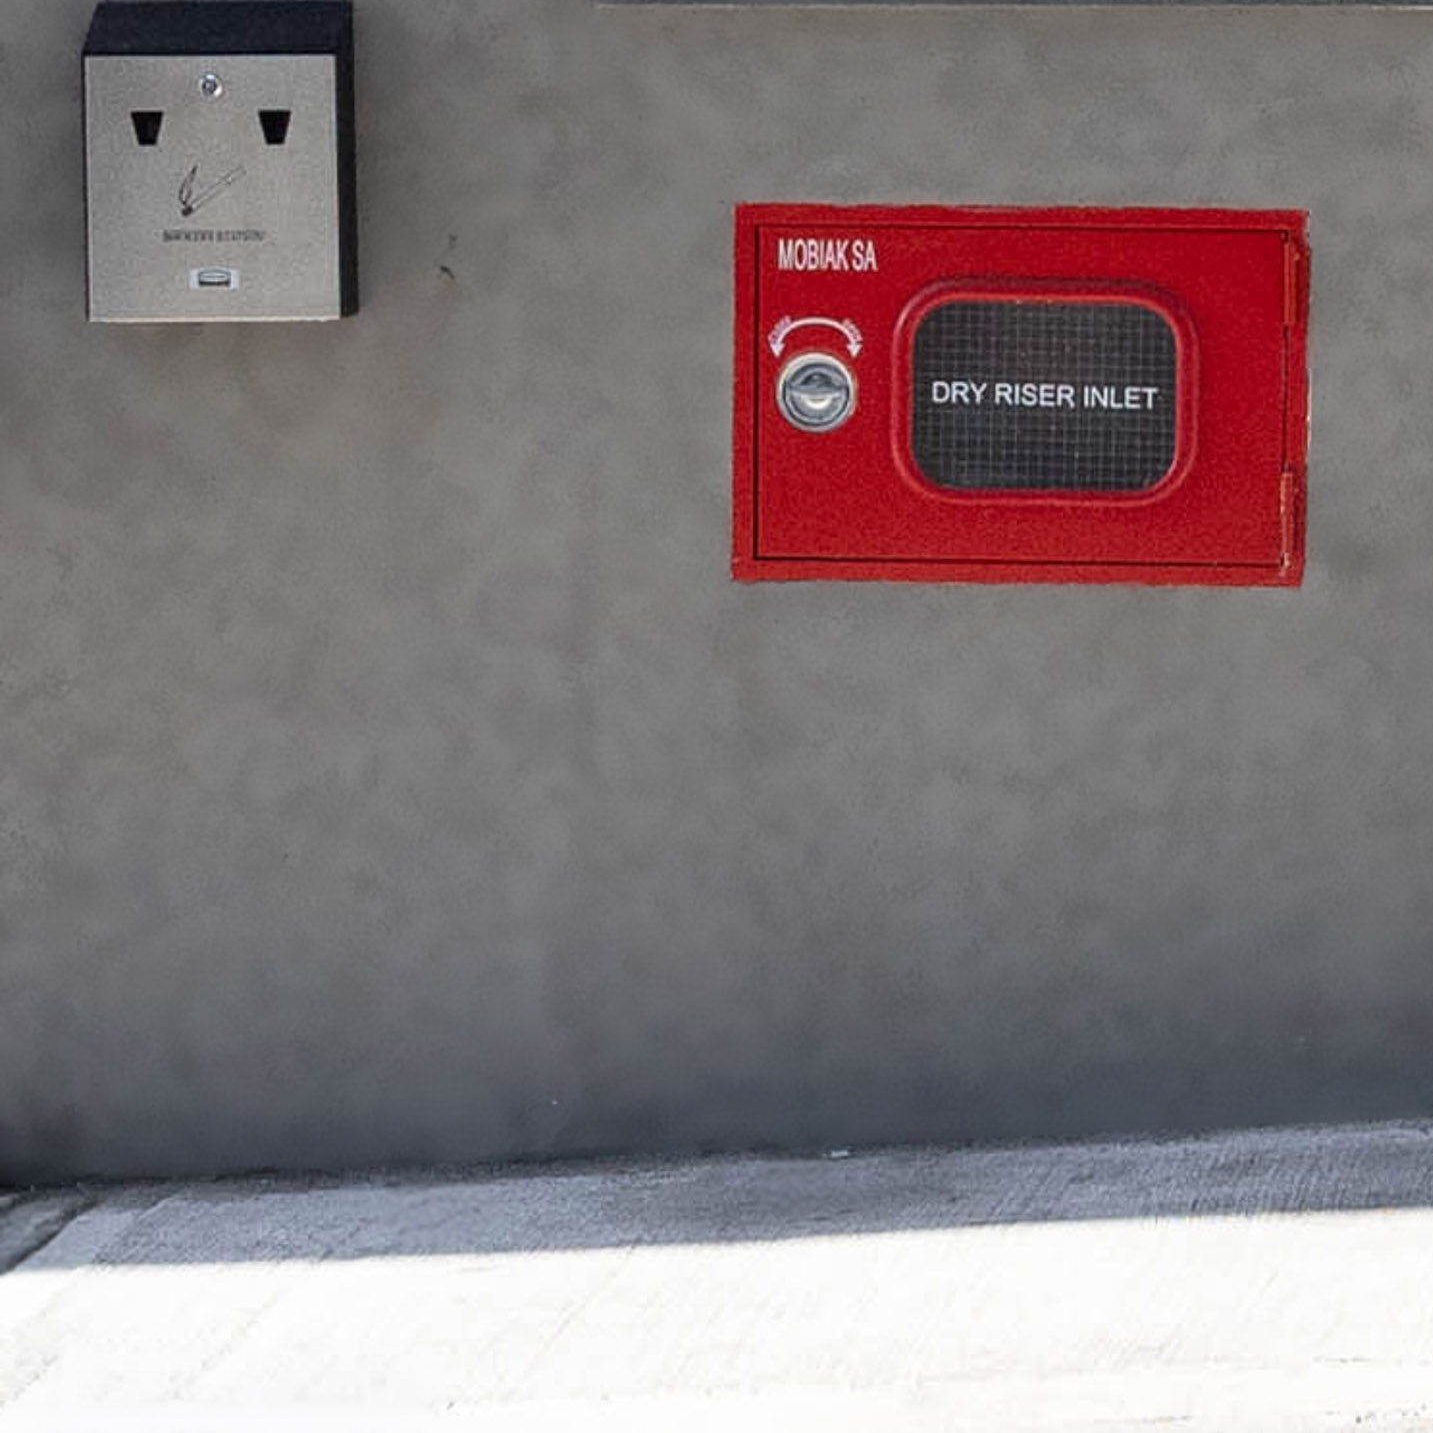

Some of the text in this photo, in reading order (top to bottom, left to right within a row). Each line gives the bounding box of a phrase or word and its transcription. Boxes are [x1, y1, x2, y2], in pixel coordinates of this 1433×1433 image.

[778, 238, 878, 271] MOBIAK SA
[931, 380, 1159, 411] DRY RISER INLET
